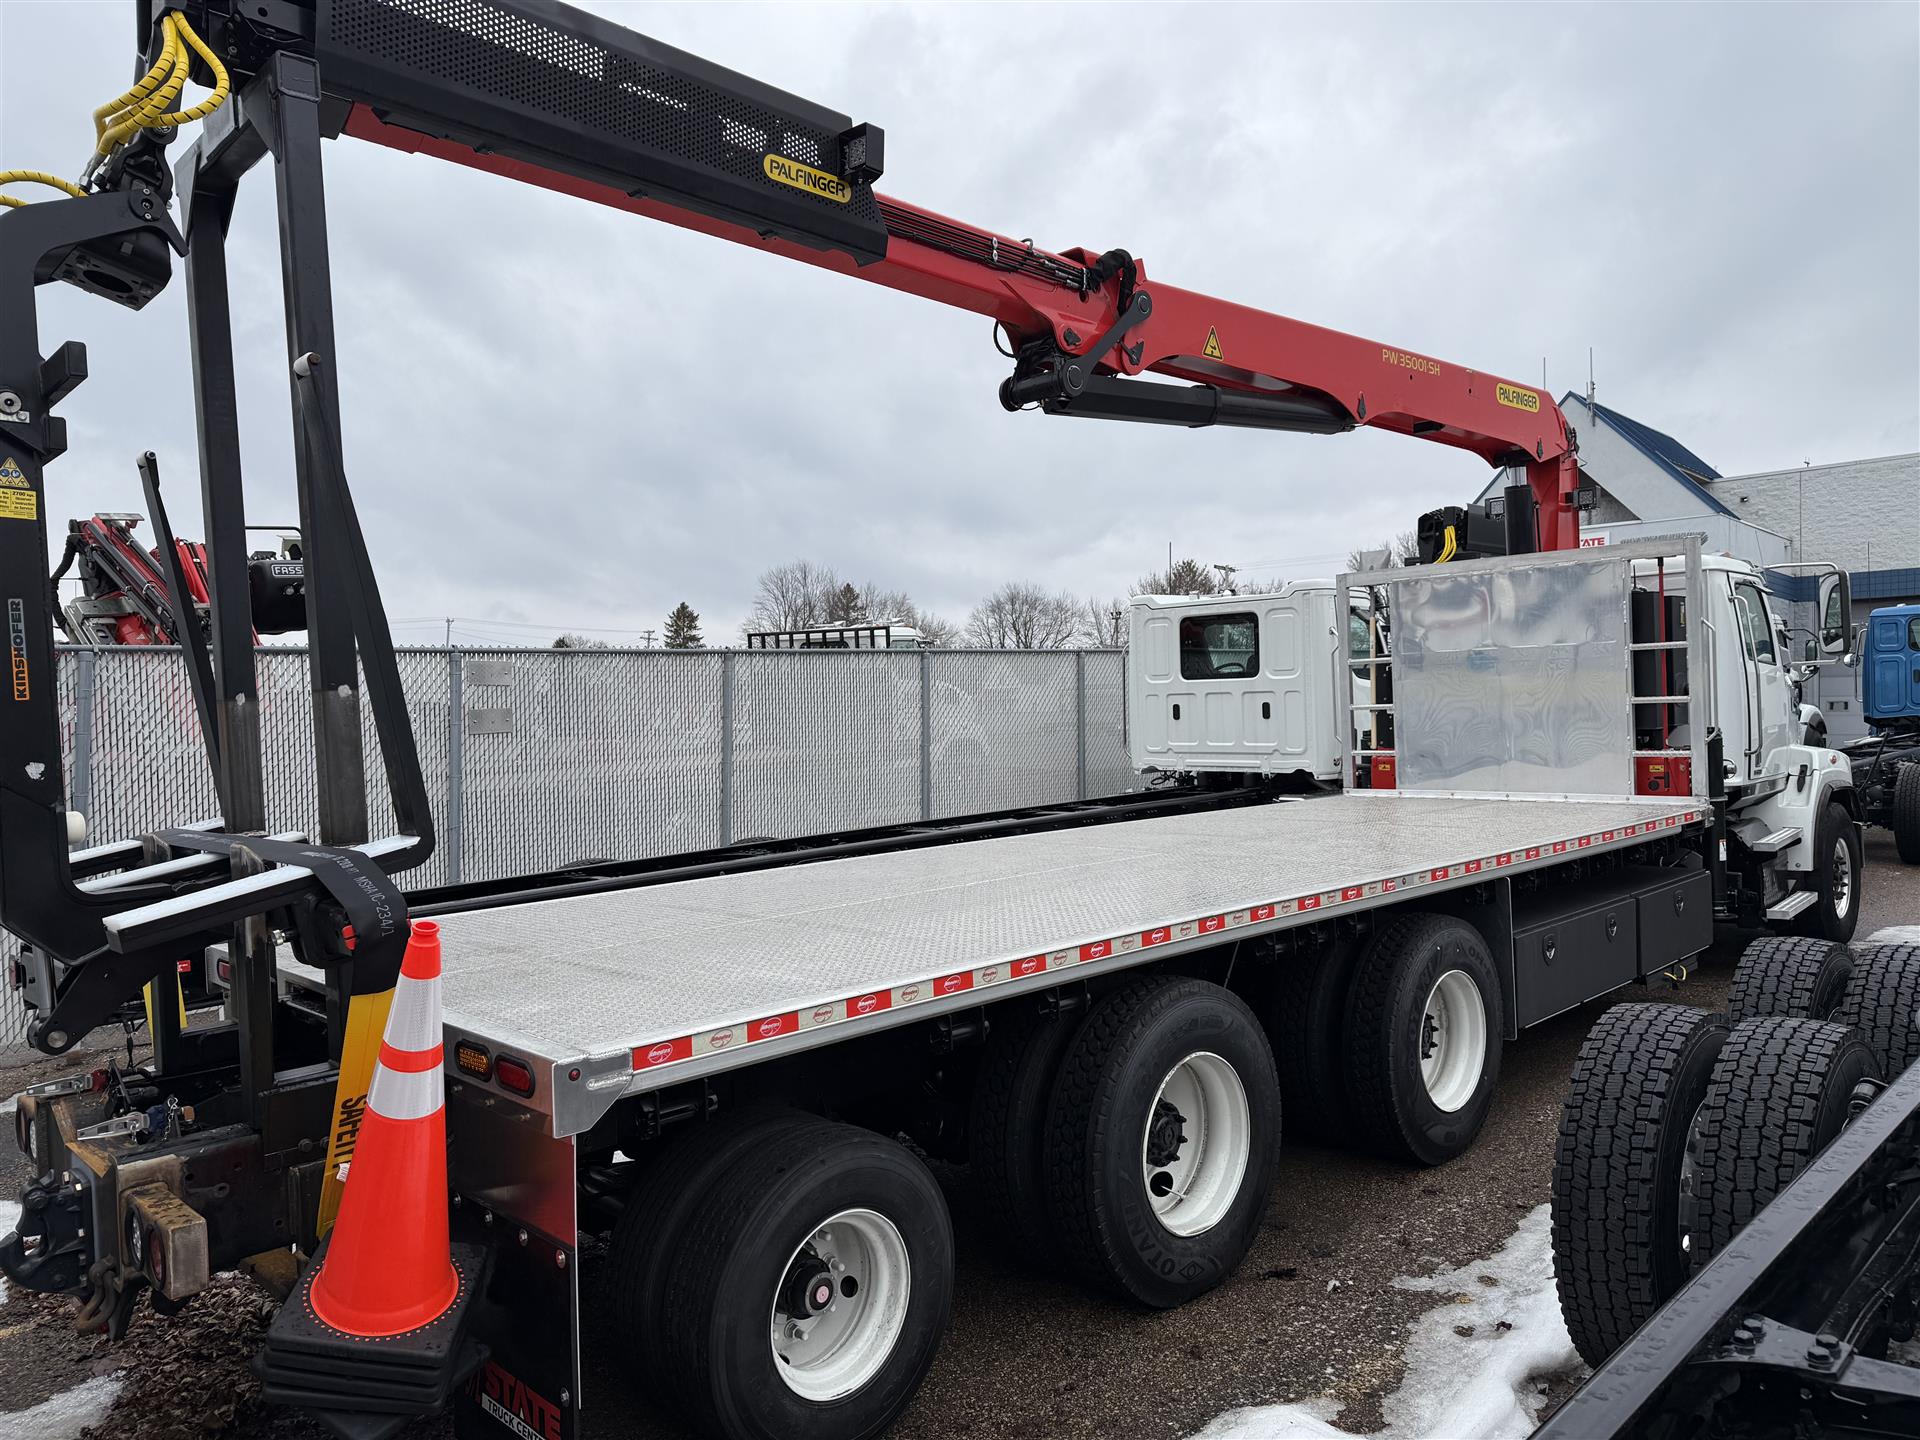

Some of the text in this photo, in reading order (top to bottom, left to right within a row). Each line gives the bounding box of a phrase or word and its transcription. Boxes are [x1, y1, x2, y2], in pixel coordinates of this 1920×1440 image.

[769, 159, 846, 198] PALFINGER
[1382, 349, 1399, 365] PW
[1498, 386, 1538, 409] PALFINGER
[1581, 537, 1605, 547] ATE
[274, 566, 304, 575] FASS
[487, 1398, 546, 1440] TRUCK CENT
